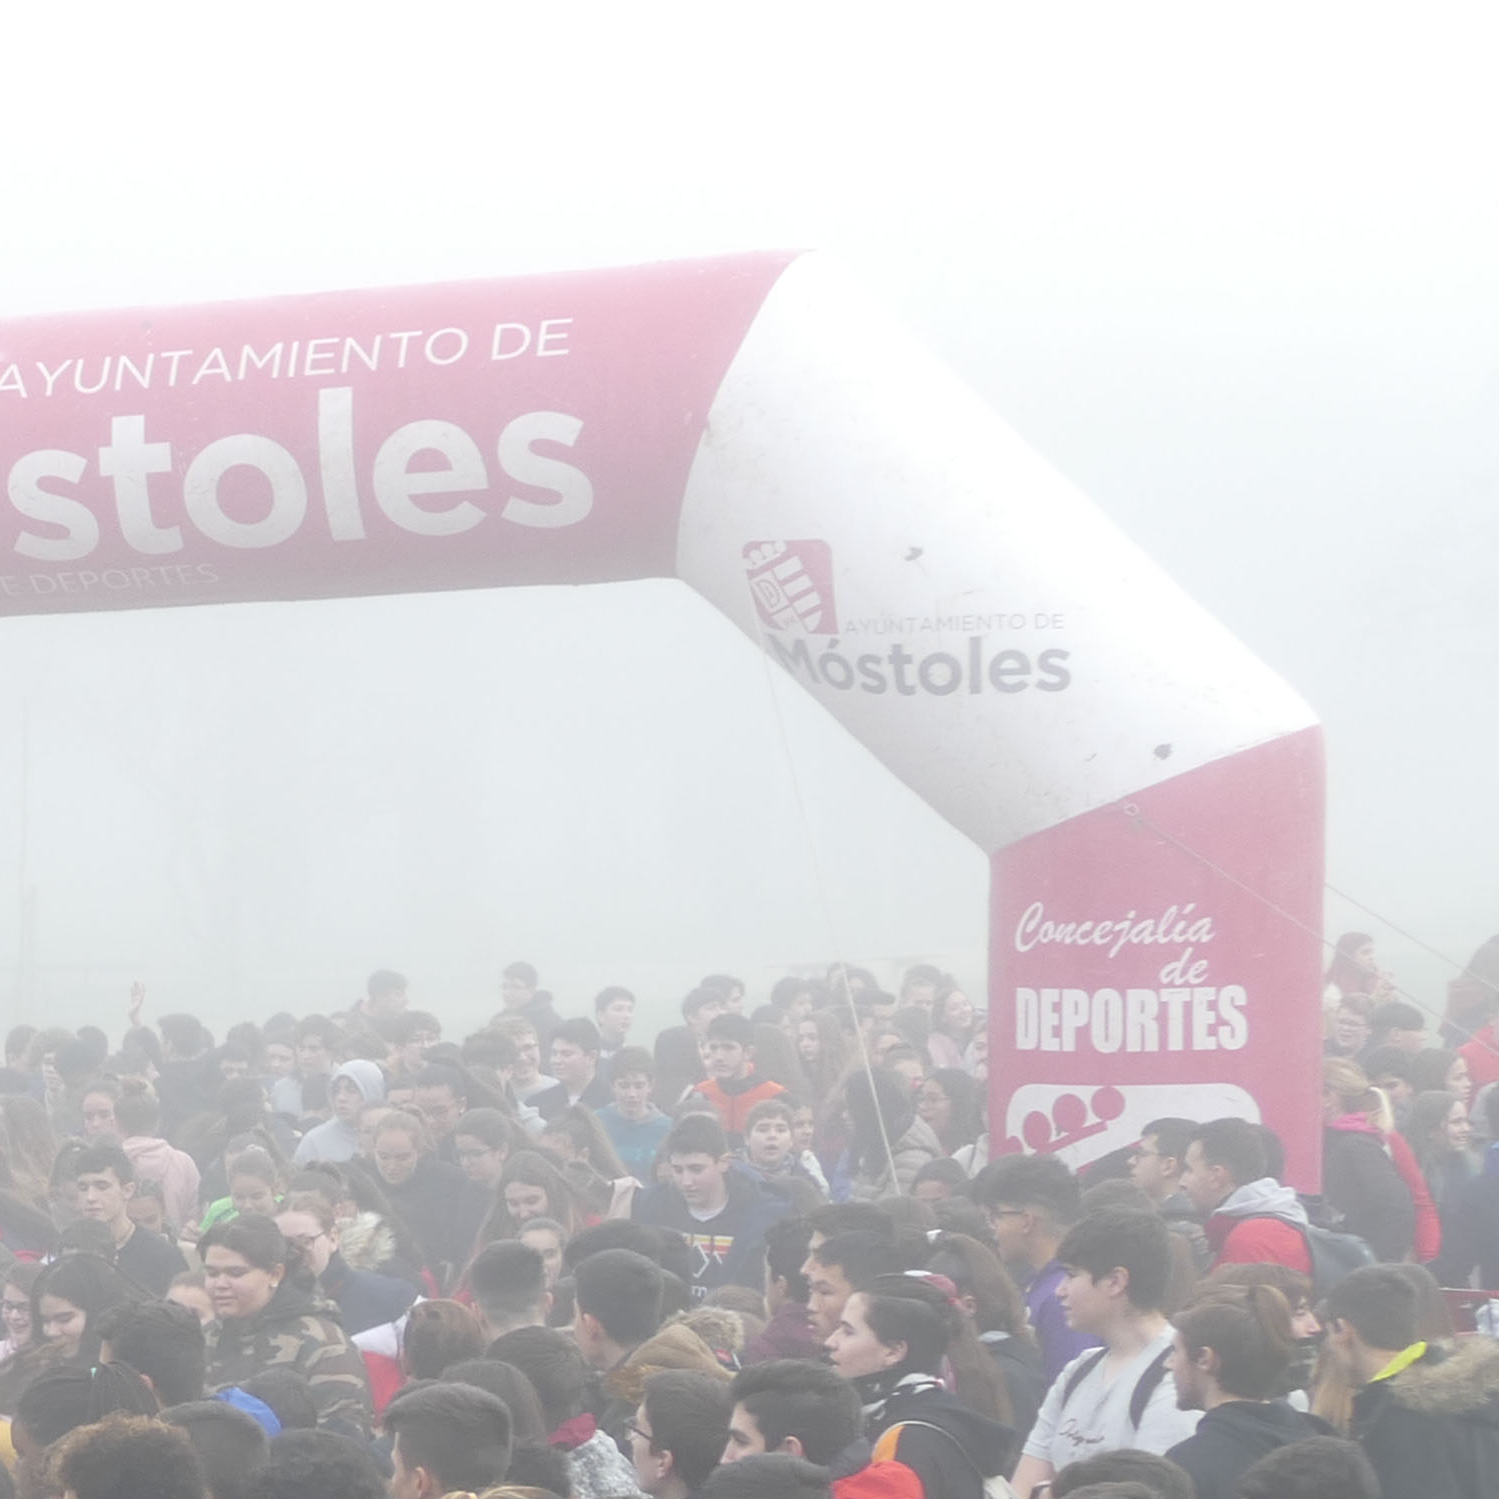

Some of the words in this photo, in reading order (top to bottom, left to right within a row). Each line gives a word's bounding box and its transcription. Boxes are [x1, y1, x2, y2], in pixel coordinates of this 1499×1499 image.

[490, 317, 574, 361] DE
[28, 562, 220, 596] DEPORTES
[844, 613, 1028, 638] AYUNTAMIENTO
[1033, 611, 1066, 630] DE
[1014, 901, 1215, 958] Concejalía
[1157, 947, 1209, 986] de
[1015, 984, 1249, 1053] DEPORTES
